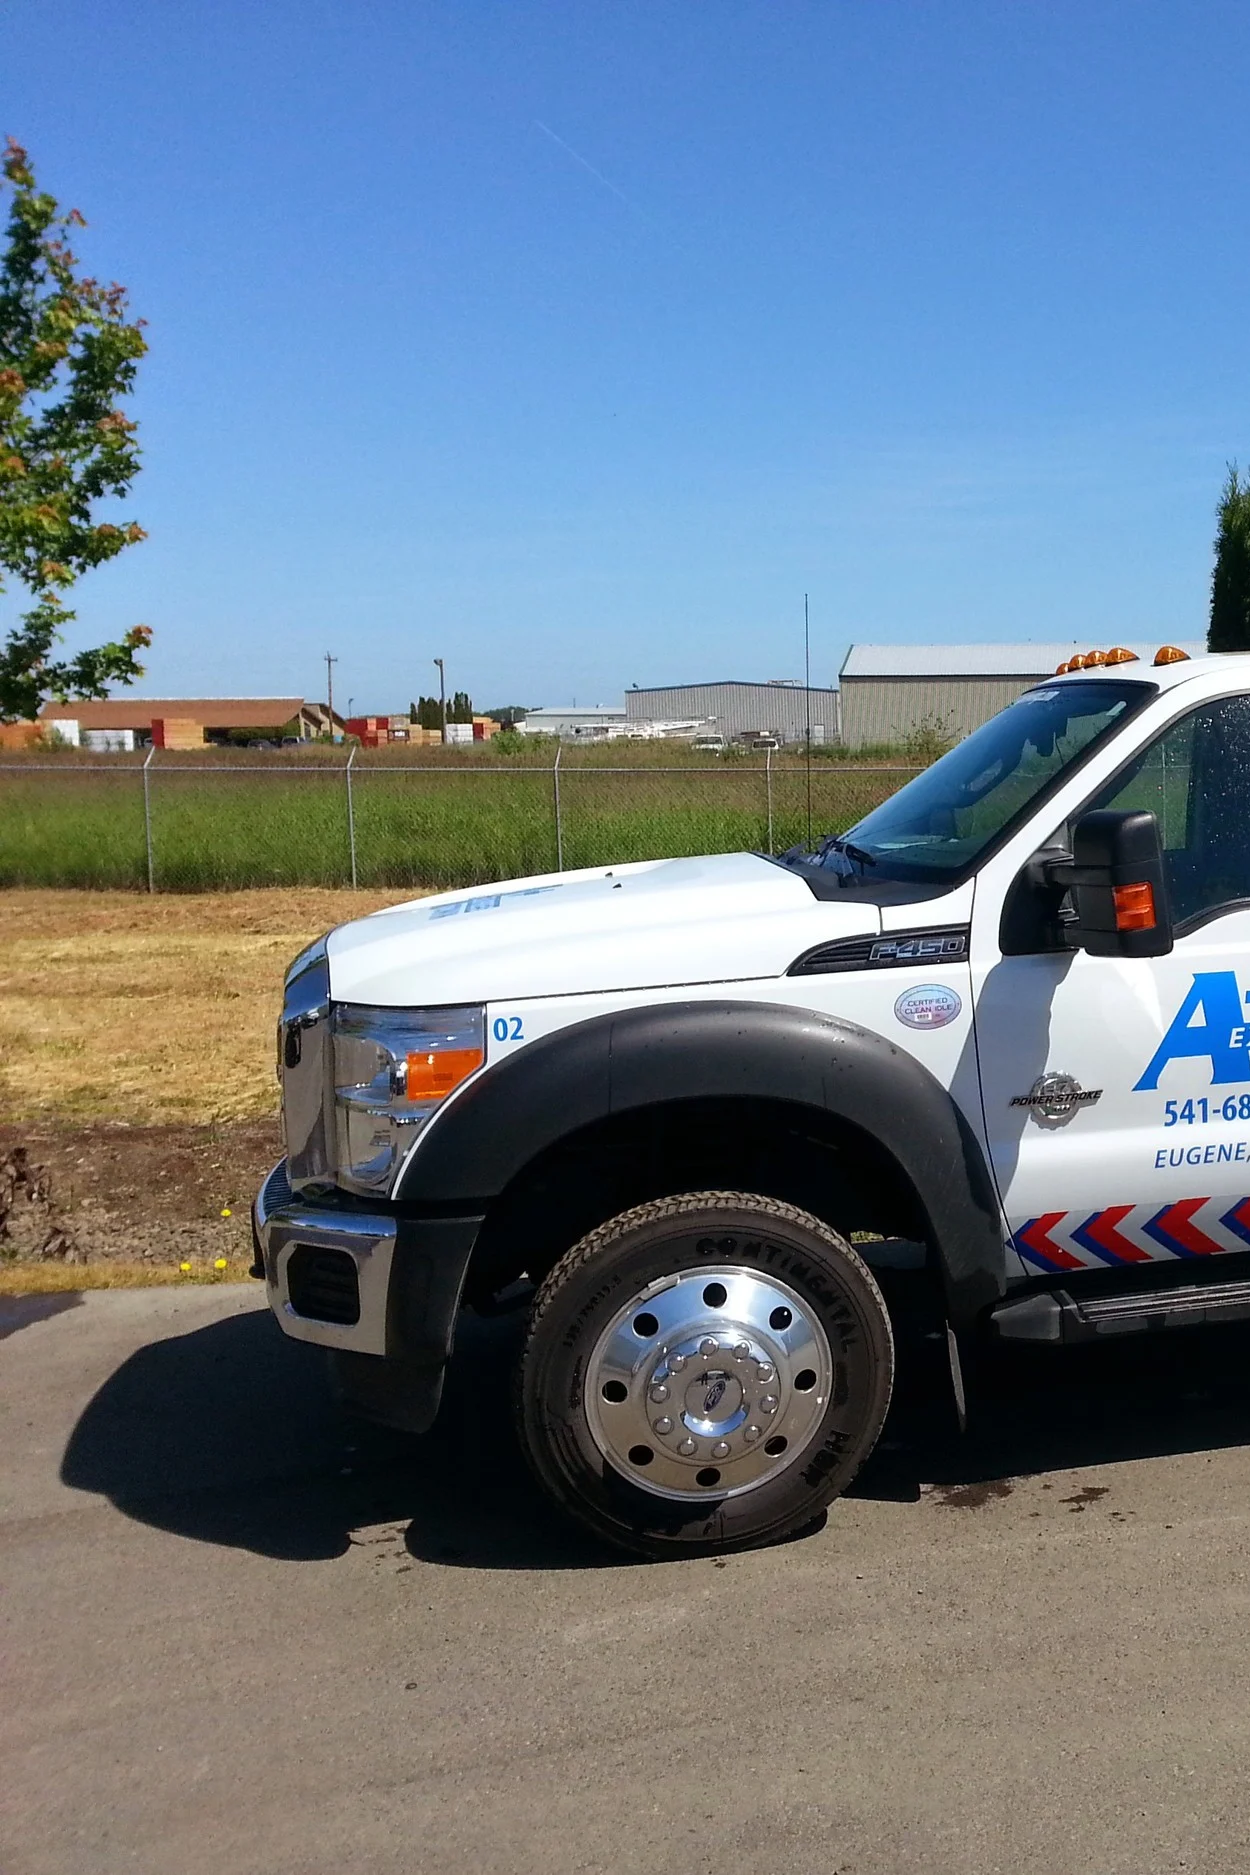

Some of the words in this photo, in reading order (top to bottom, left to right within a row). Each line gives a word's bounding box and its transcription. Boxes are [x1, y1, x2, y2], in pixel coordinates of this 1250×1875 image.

[868, 936, 966, 961] F-450
[904, 1006, 932, 1015] CLEAN
[934, 1003, 953, 1012] IDLE
[907, 997, 948, 1007] CERTIFIED
[492, 1016, 525, 1043] 02
[1010, 1096, 1054, 1107] POWER
[1055, 1089, 1103, 1103] STROKE
